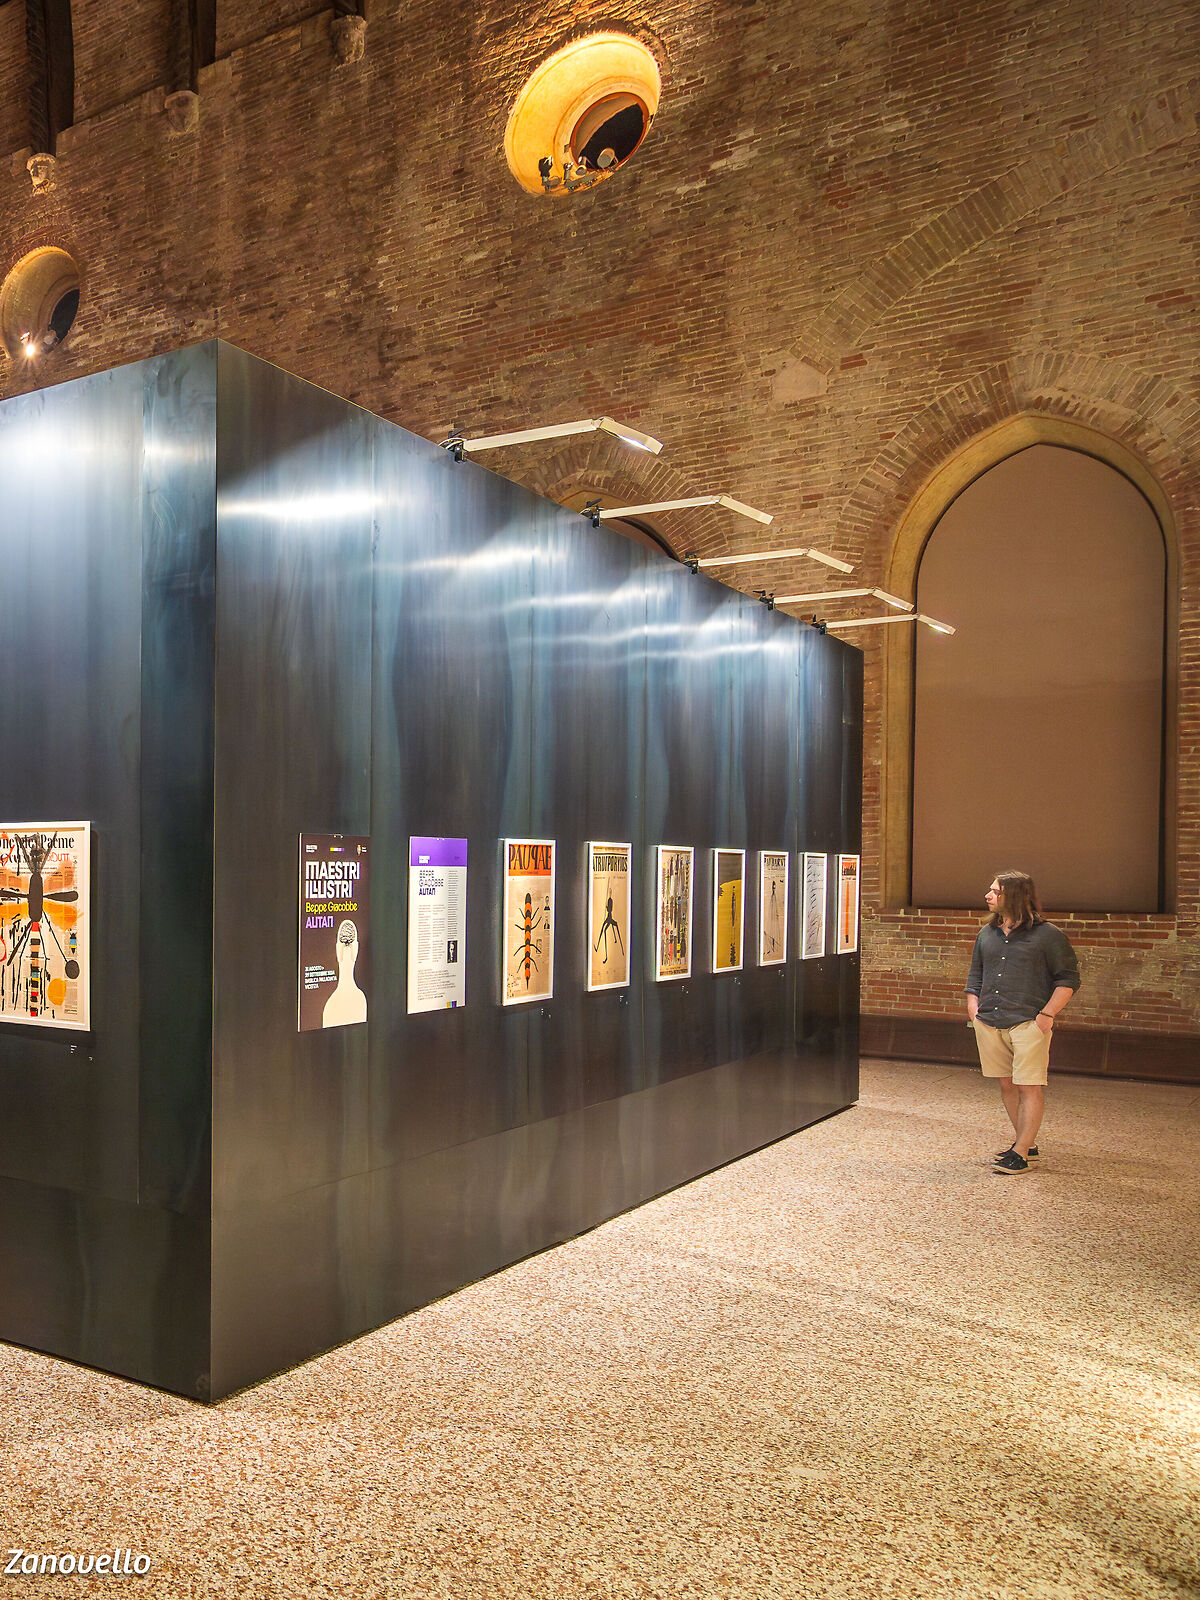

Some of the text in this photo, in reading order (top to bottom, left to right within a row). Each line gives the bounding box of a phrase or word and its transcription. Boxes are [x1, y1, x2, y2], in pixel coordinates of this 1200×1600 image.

[305, 861, 360, 880] MAESTRI
[305, 880, 353, 899] ILLUSTRI
[305, 900, 359, 915] Beppe Giacobbe
